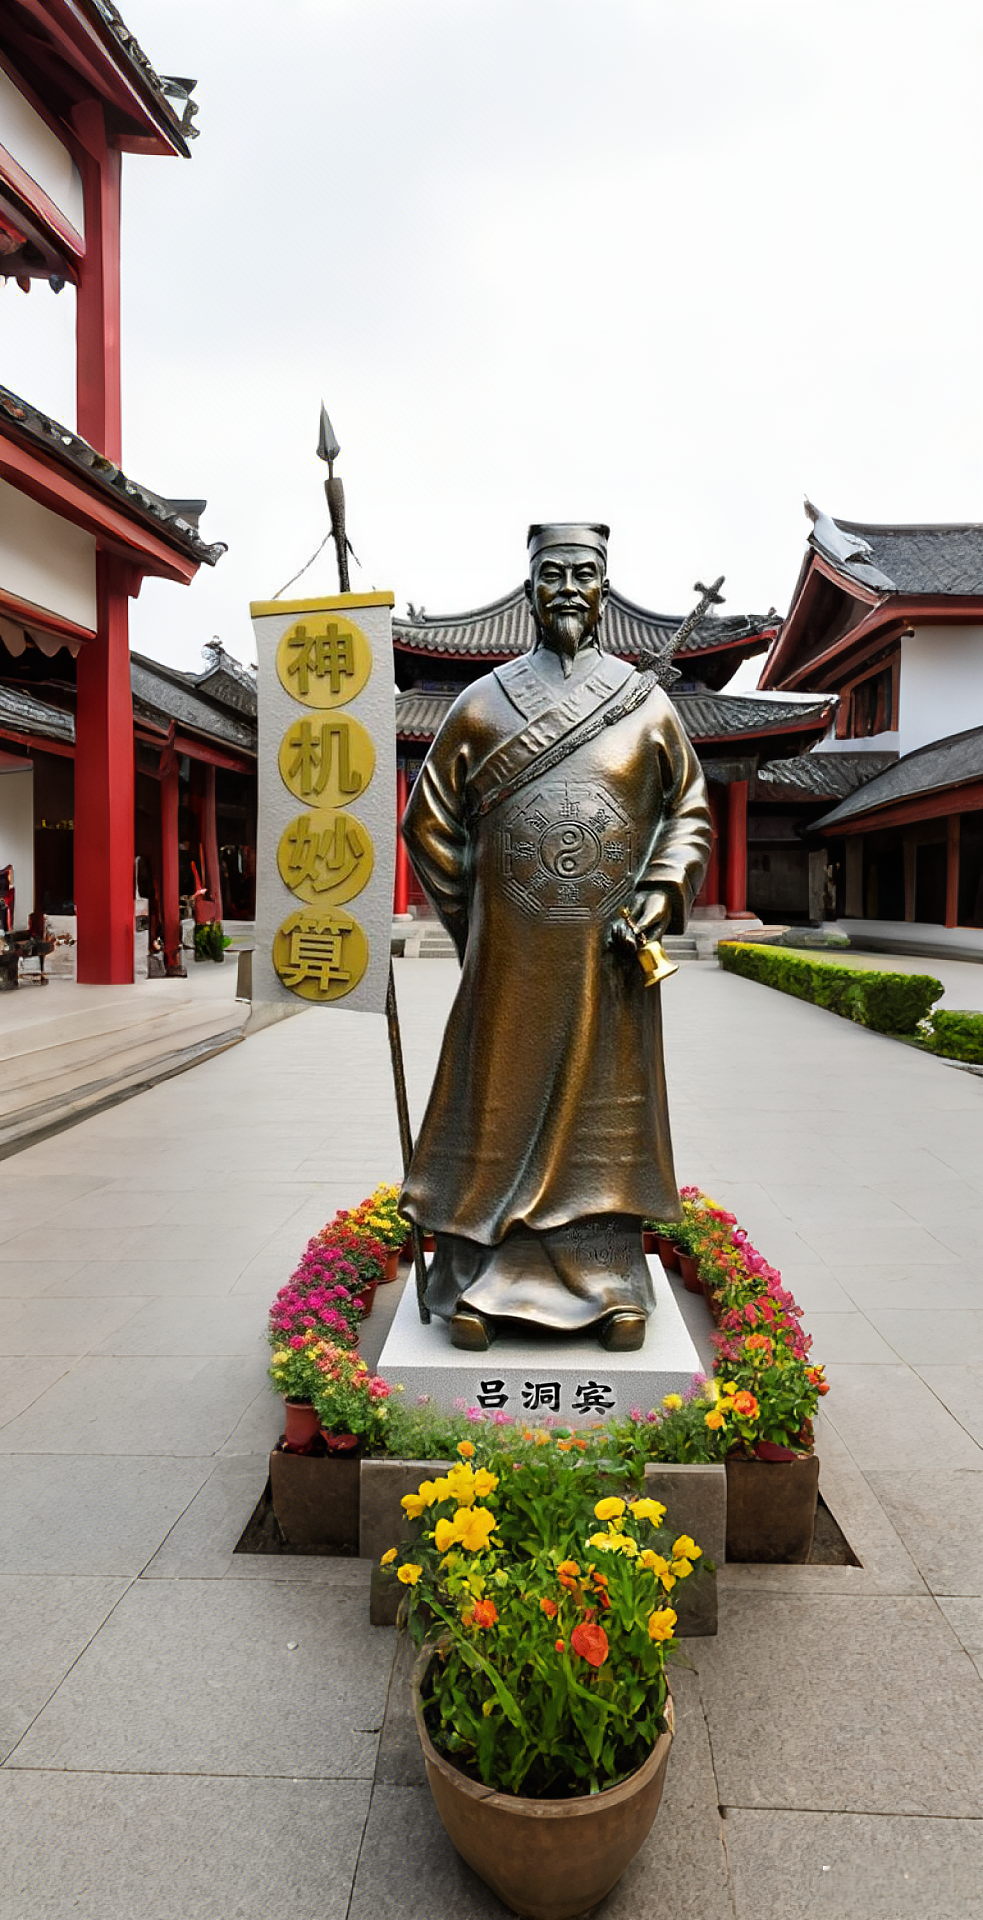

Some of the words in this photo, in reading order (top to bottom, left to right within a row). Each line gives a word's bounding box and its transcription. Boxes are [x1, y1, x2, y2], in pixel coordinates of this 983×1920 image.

[279, 622, 364, 992] 神机妙算
[477, 1380, 616, 1415] 吕洞宾
